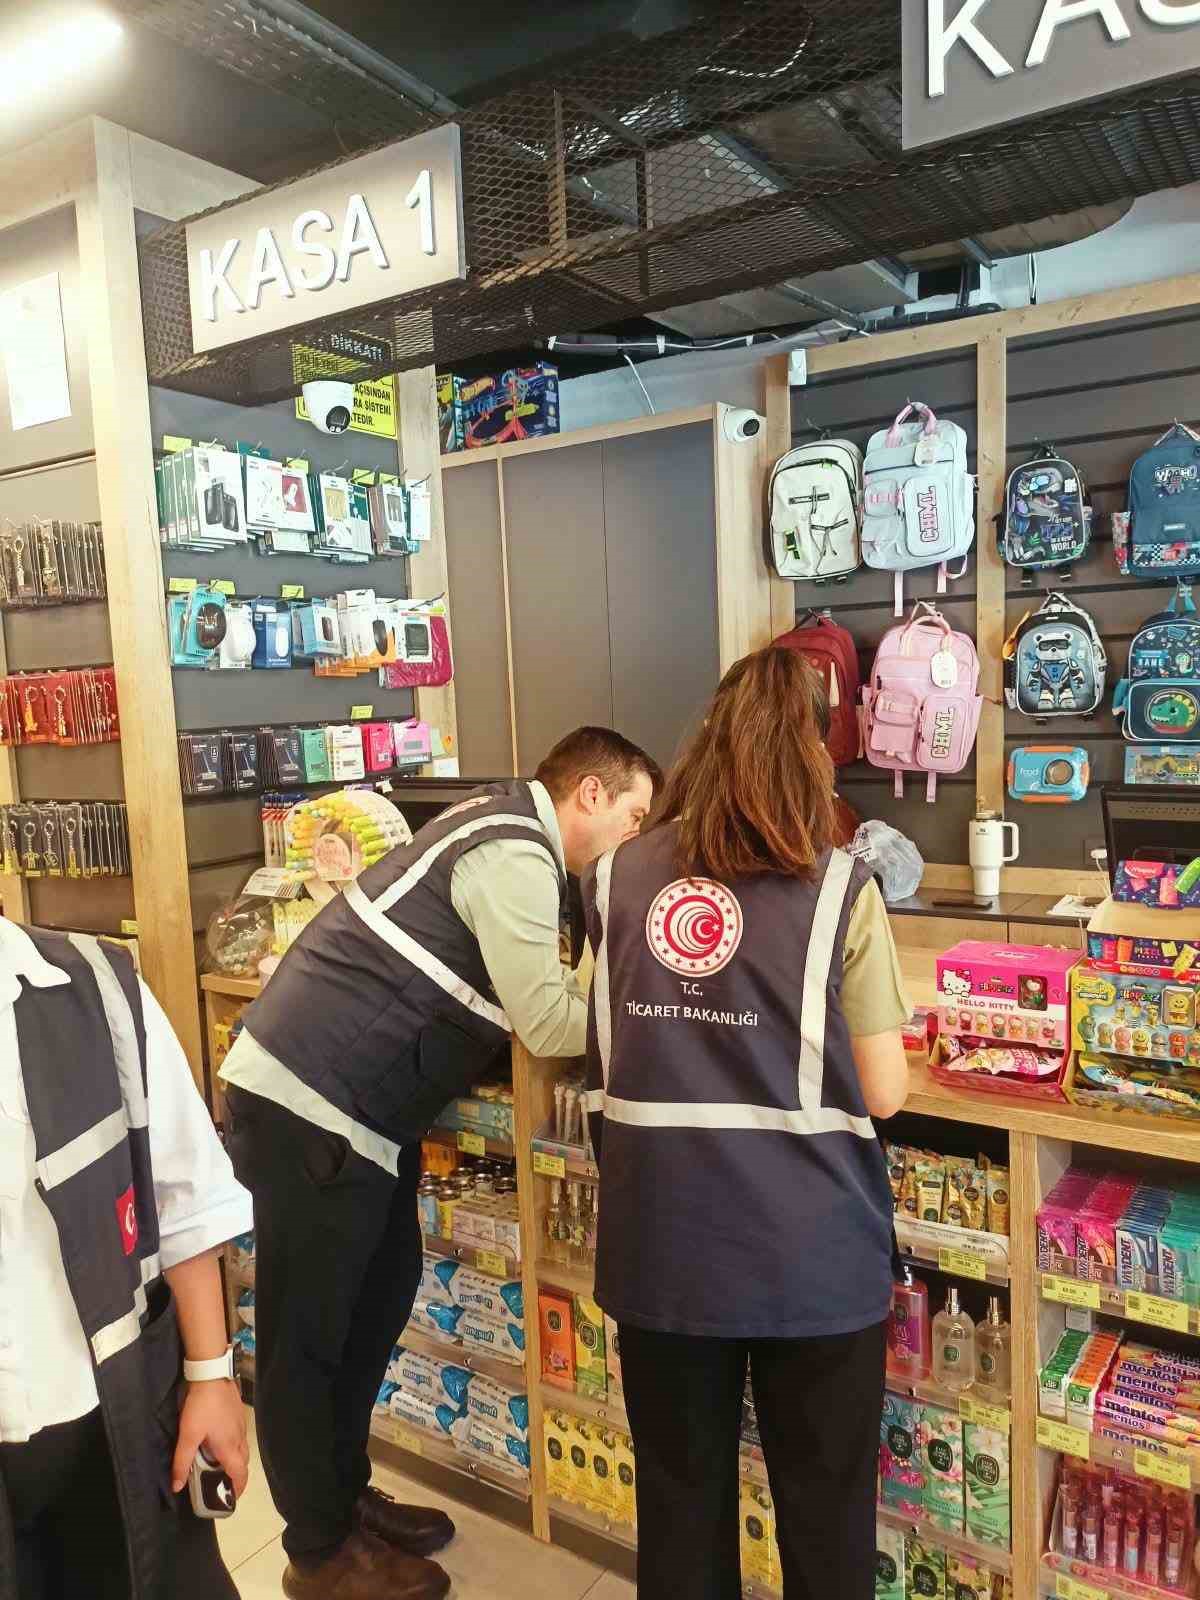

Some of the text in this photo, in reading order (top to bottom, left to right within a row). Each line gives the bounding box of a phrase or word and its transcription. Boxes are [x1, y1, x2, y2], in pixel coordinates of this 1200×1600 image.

[927, 0, 1200, 98] KA
[199, 168, 436, 323] KASA 1
[1050, 540, 1077, 553] WORLD
[680, 981, 703, 996] T.C.
[626, 1000, 758, 1026] TİCARET BAKANLIĞI
[957, 997, 1016, 1011] HELLO KITTY
[1116, 1373, 1176, 1396] mentos
[1104, 1399, 1166, 1426] mentos
[1102, 1428, 1169, 1455] mentos
